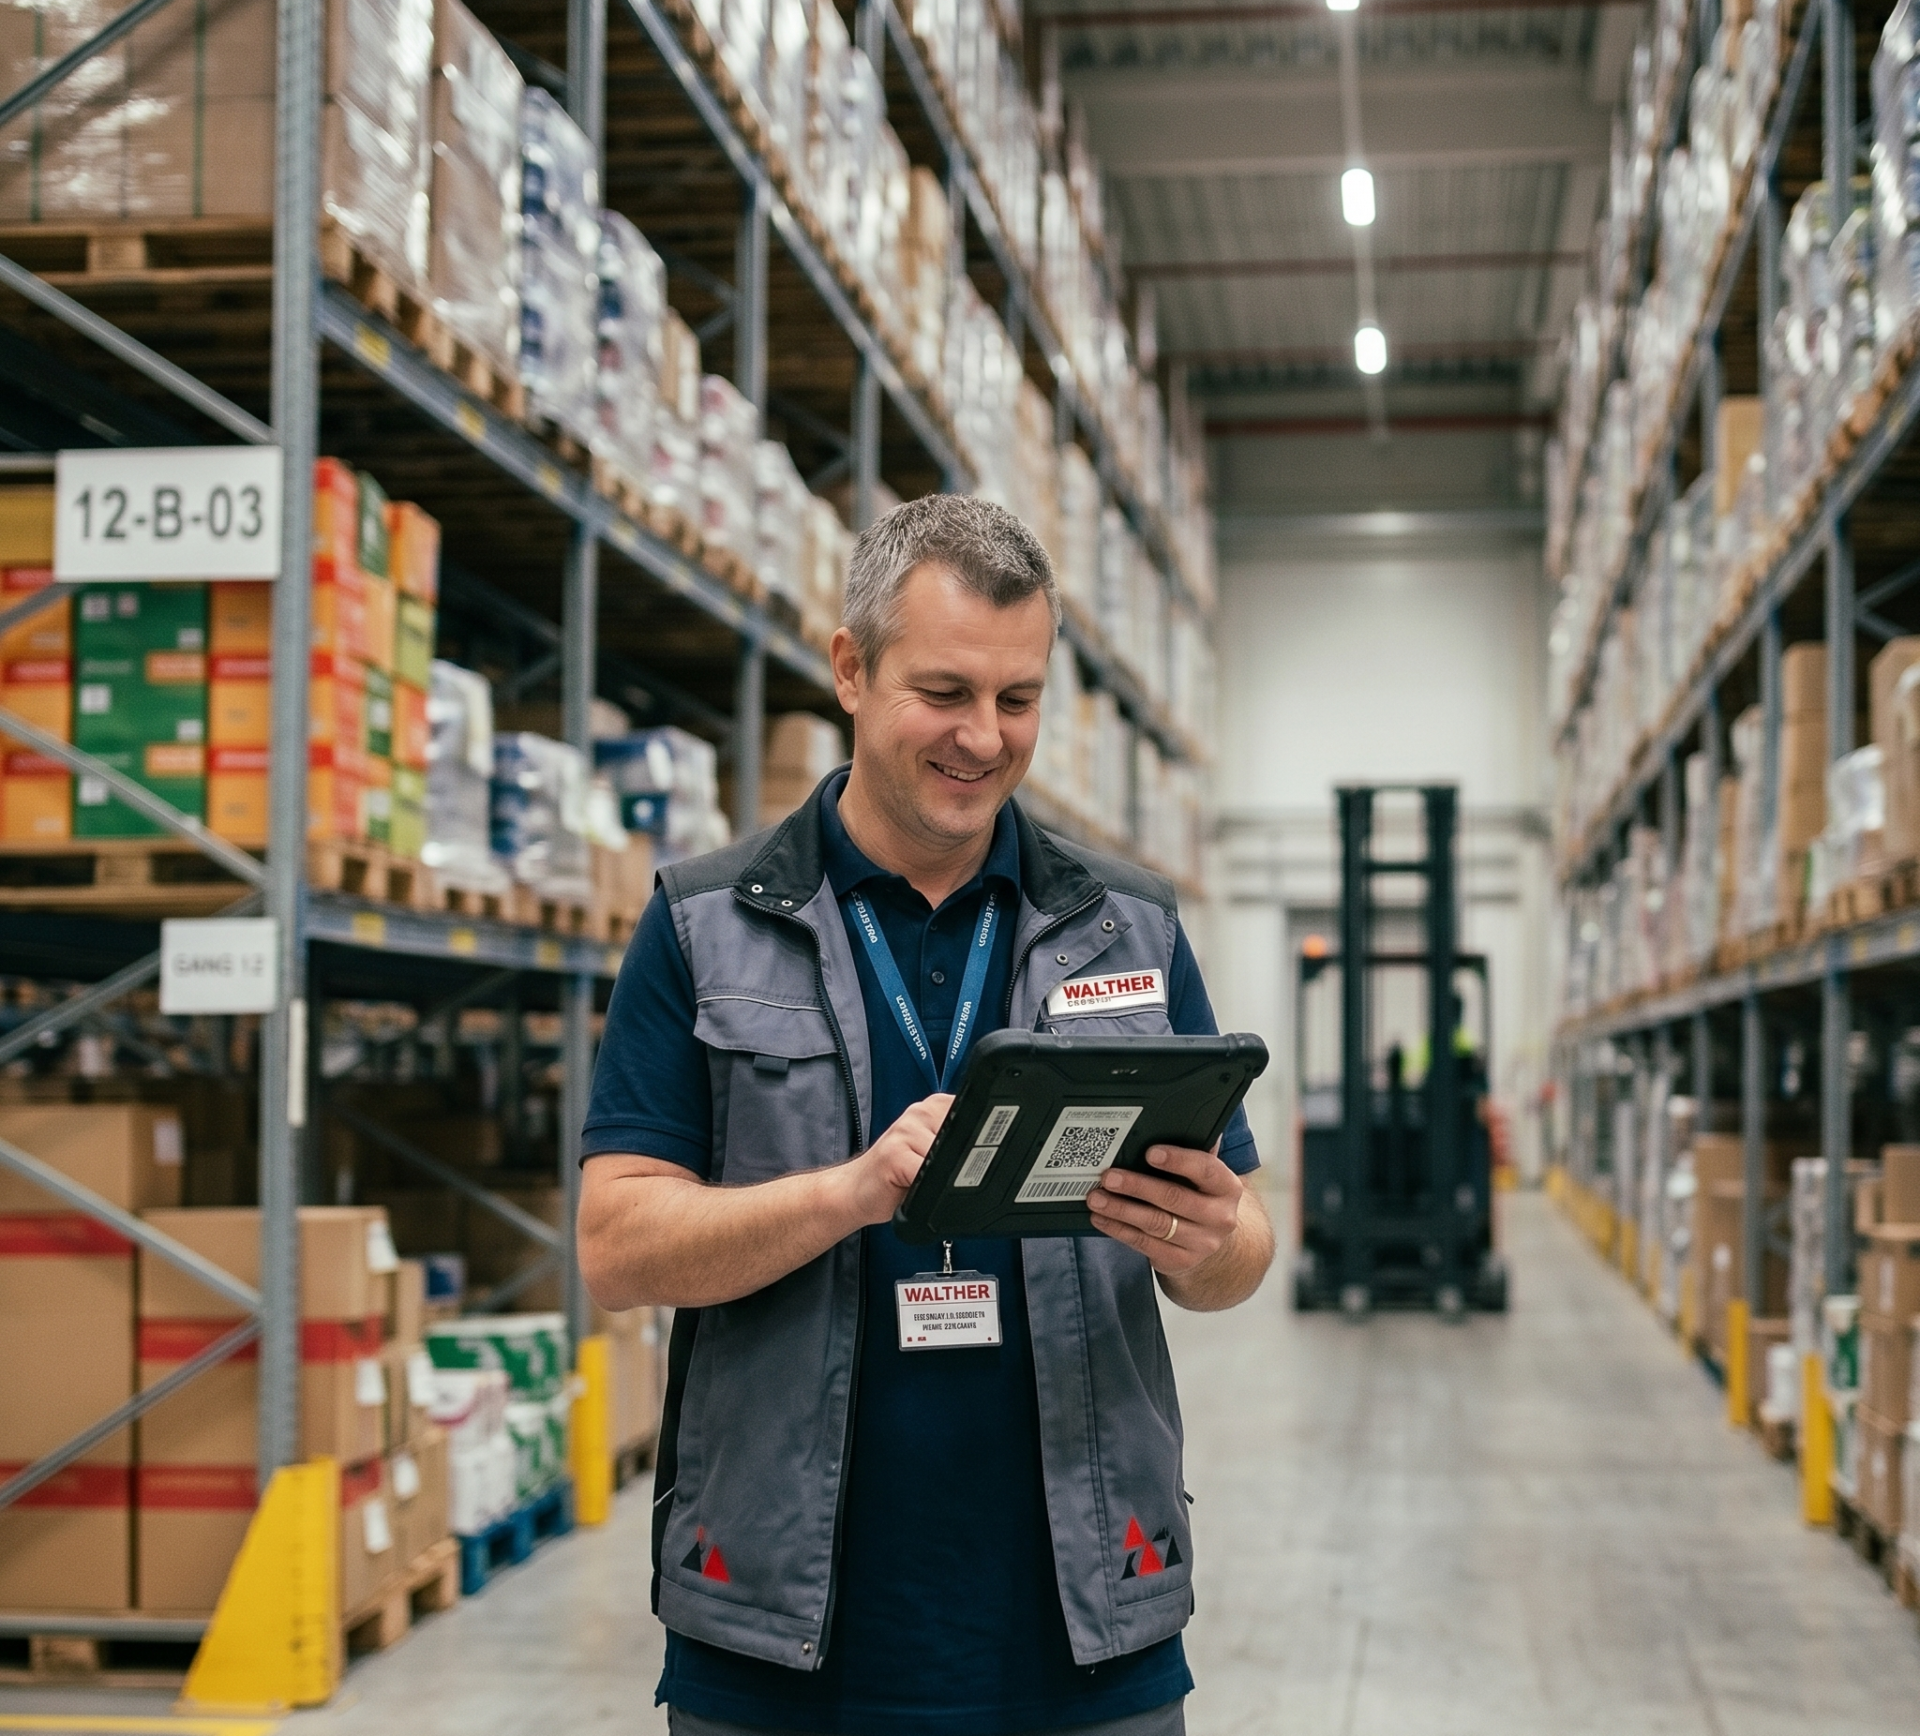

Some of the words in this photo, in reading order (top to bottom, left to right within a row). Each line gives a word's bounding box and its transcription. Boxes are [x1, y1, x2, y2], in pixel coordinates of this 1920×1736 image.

[75, 485, 264, 540] 12-B-03
[1063, 975, 1155, 1000] WALTHER
[904, 1284, 990, 1302] WALTHER
